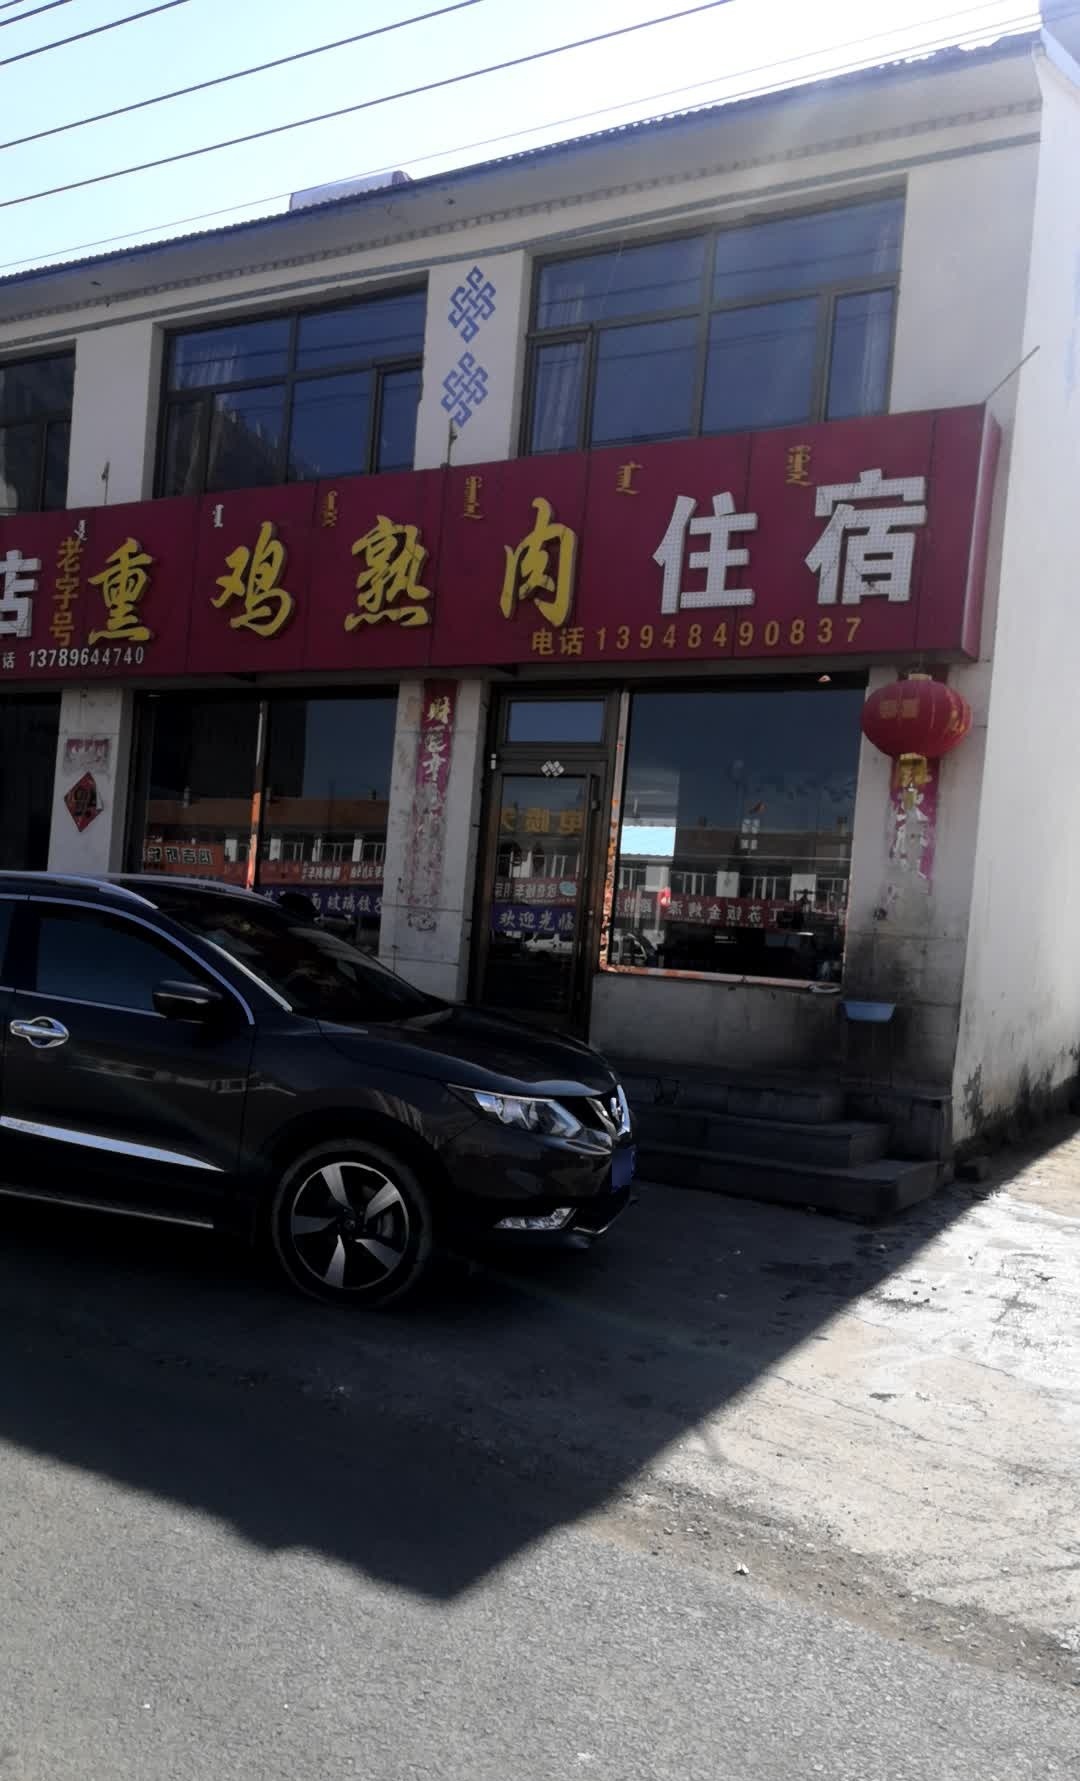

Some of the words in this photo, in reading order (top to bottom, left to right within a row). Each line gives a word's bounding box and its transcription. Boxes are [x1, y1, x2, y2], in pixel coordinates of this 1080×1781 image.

[652, 468, 929, 614] 住宿
[50, 537, 83, 648] 老字号
[531, 627, 585, 656] 电话
[597, 617, 863, 651] 13948490837
[28, 646, 144, 668] 13789644740
[498, 909, 577, 932] 欢迎光临
